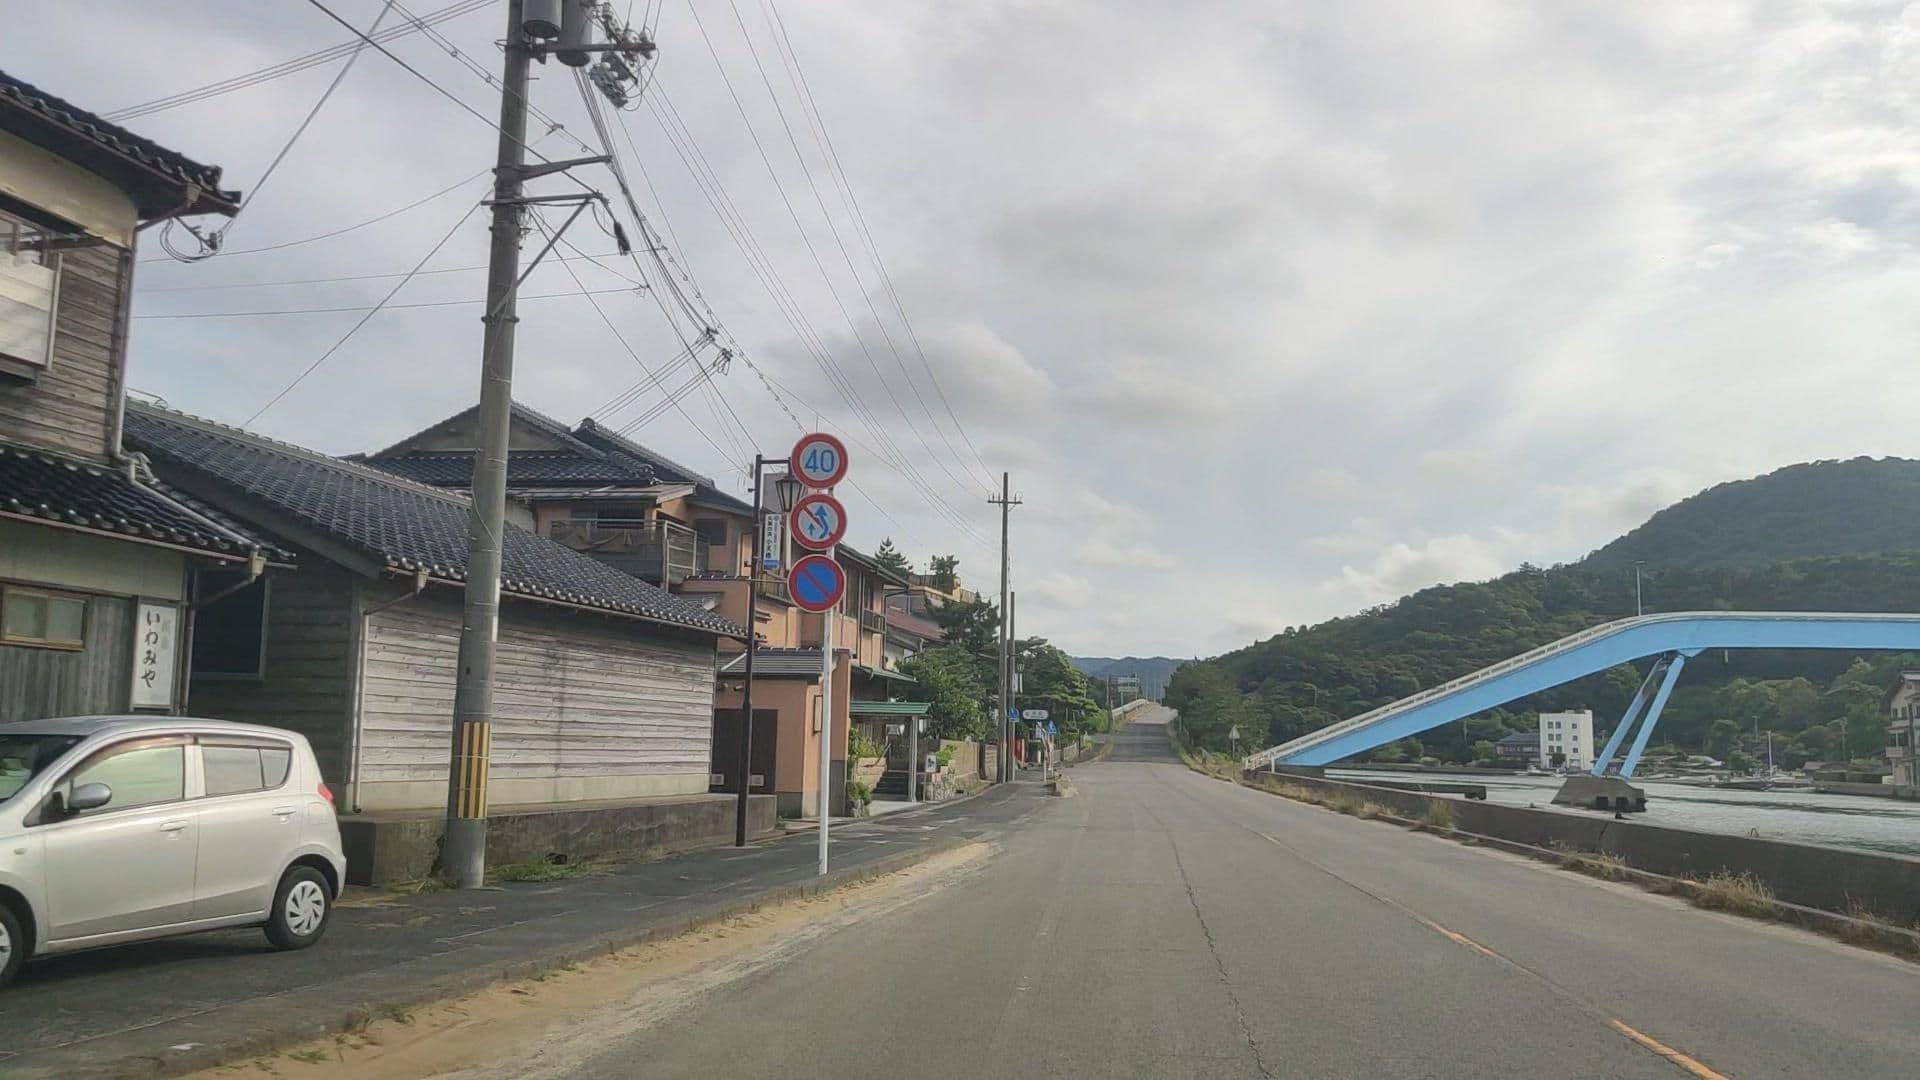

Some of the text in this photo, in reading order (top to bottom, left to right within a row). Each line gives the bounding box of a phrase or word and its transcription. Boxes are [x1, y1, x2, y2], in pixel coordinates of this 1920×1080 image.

[804, 449, 834, 472] 40
[141, 610, 160, 688] いわみや
